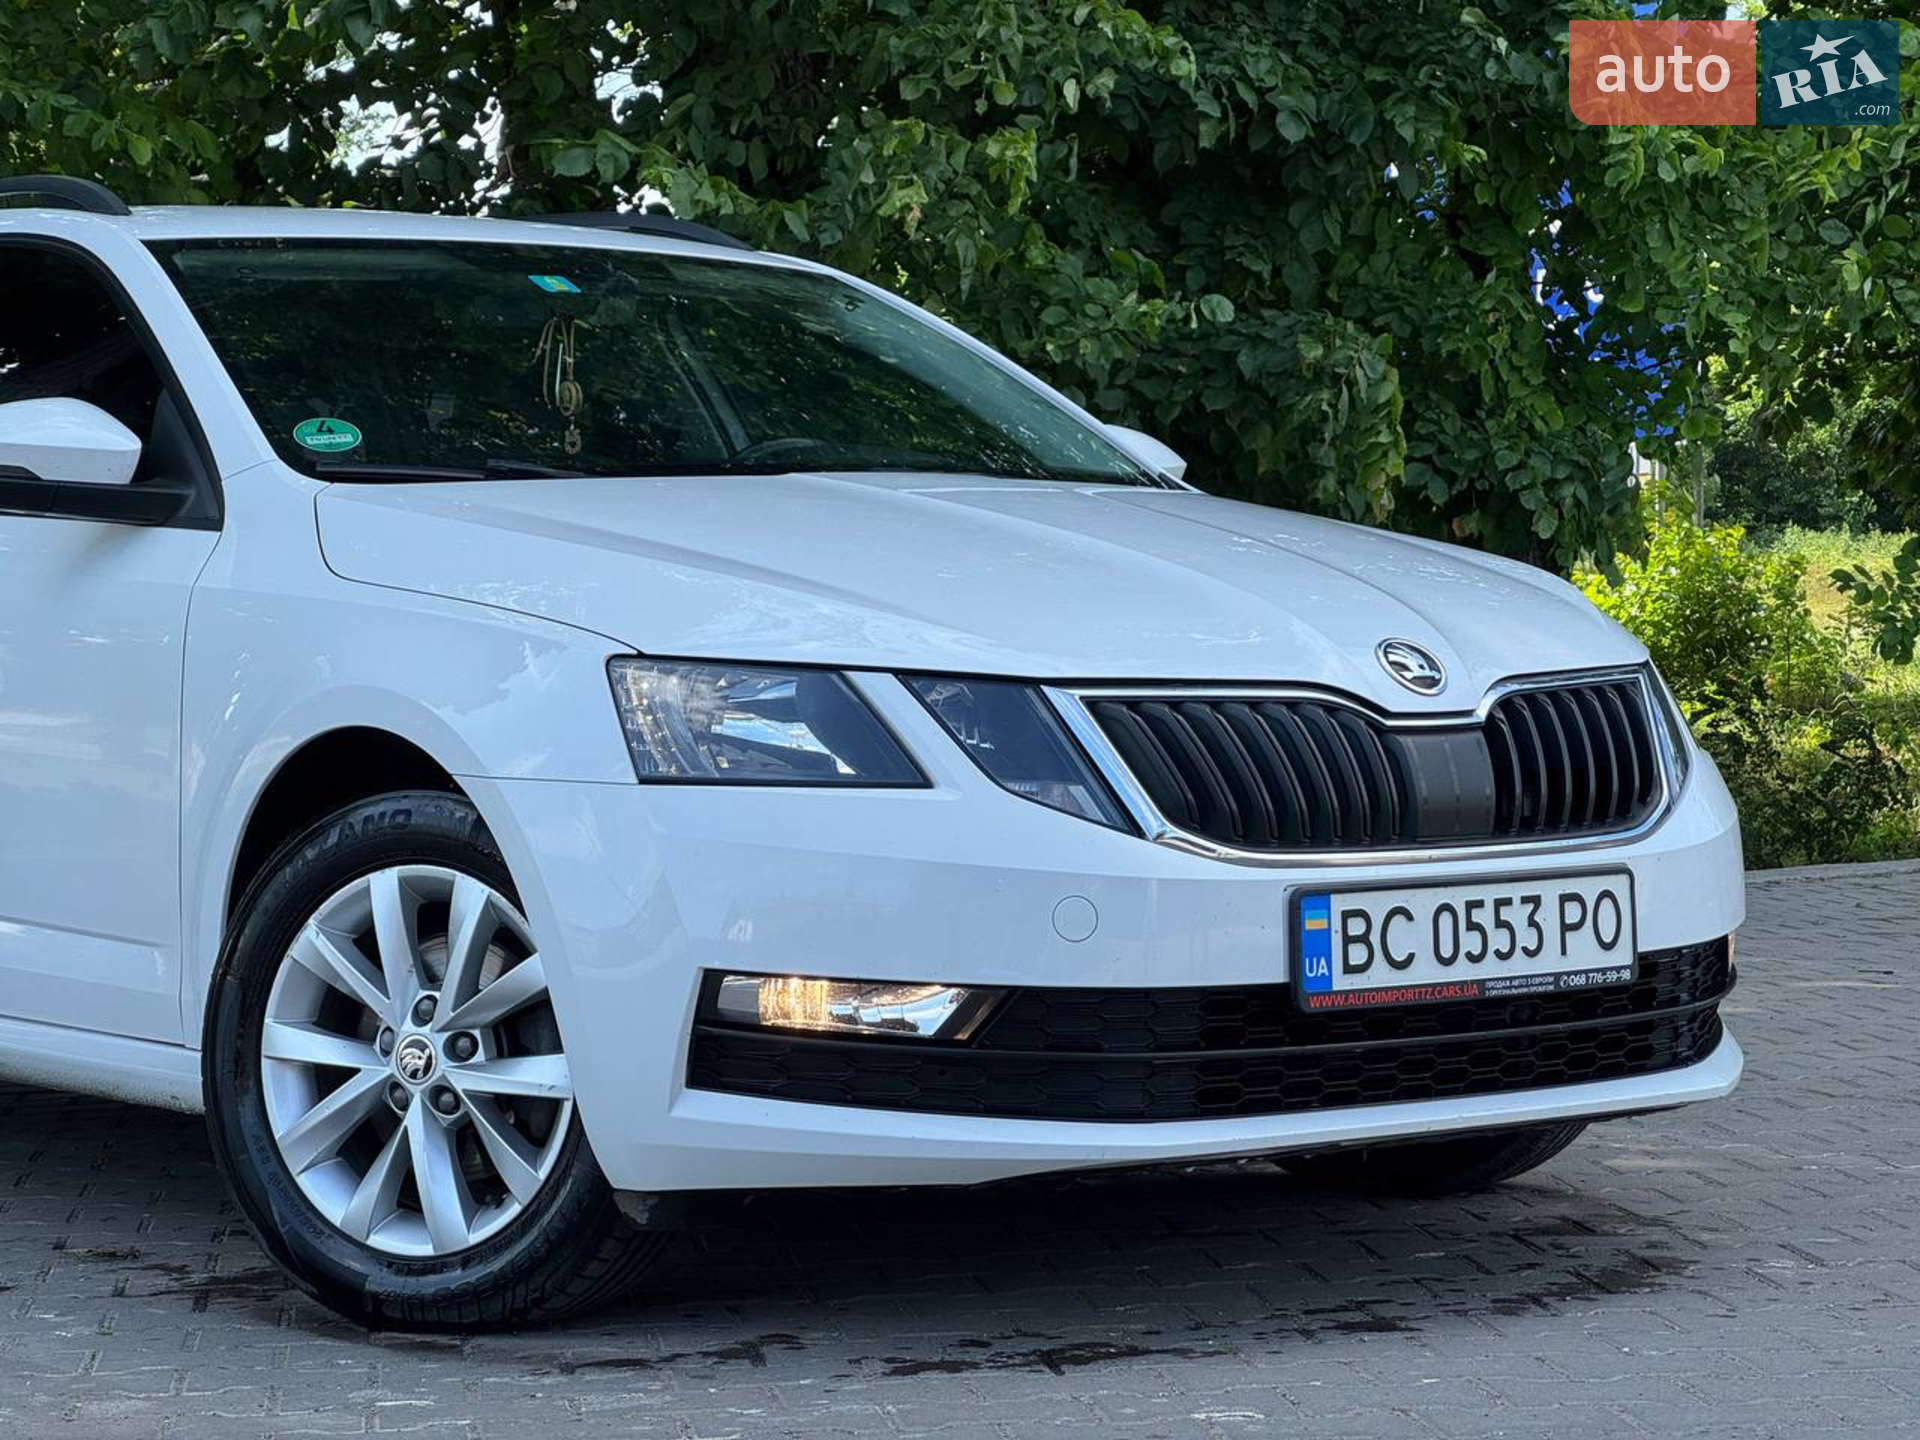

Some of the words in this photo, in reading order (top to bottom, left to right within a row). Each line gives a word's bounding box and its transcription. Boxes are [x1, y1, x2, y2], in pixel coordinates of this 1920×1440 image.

[317, 420, 334, 434] 4
[1340, 906, 1416, 975] BC
[1432, 894, 1545, 967] 0553
[1558, 889, 1622, 957] PO
[1305, 956, 1329, 978] UA
[1568, 973, 1586, 986] 068
[1587, 968, 1632, 984] 776-59-98
